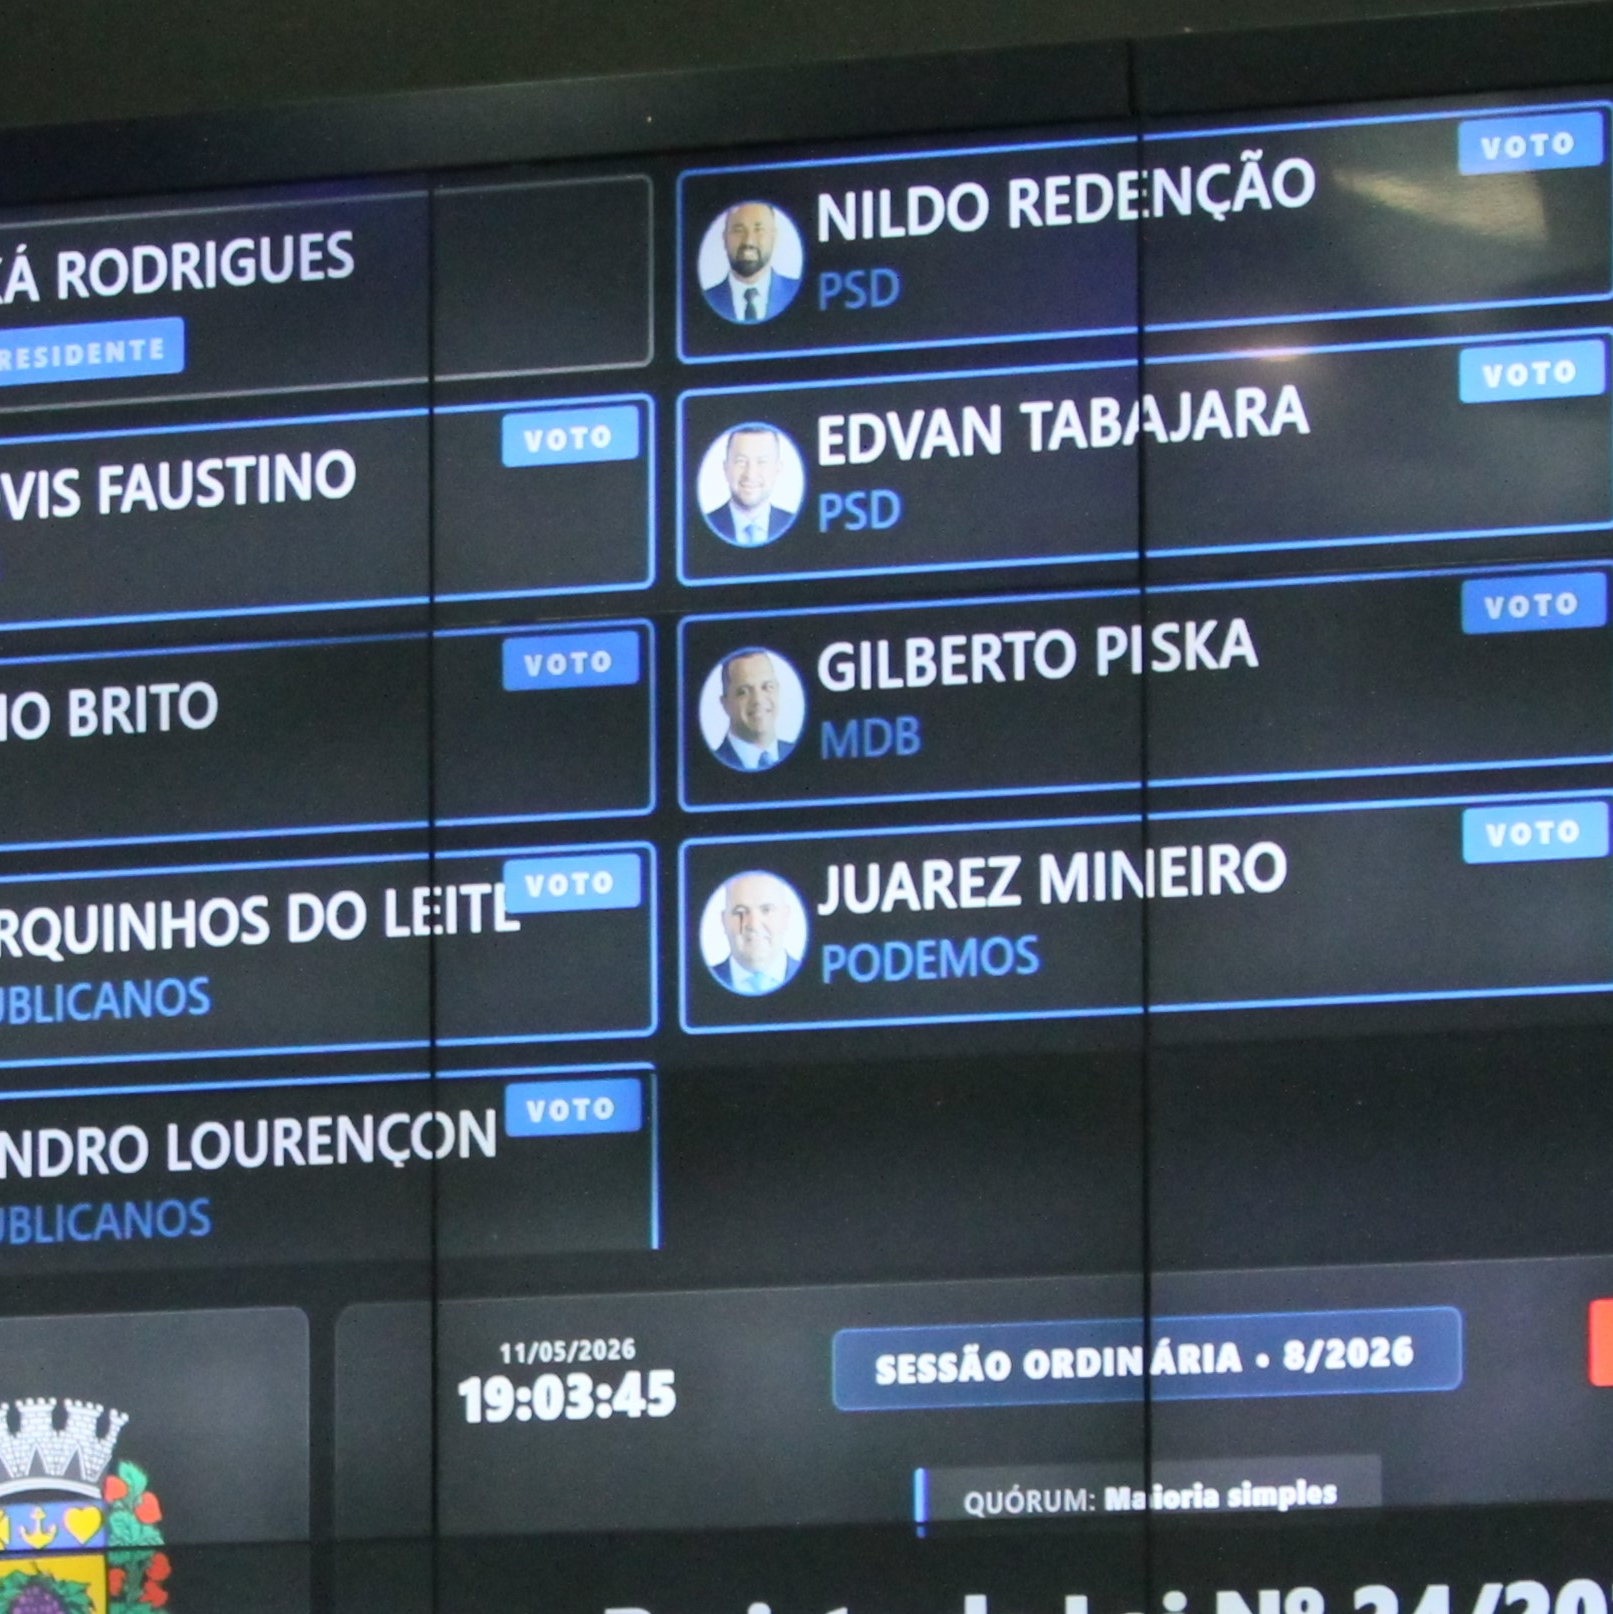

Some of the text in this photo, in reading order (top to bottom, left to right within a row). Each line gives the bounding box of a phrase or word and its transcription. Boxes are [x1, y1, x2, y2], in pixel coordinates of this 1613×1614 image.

[1481, 132, 1574, 158] VOTO
[817, 149, 1315, 242] NILDO REDENÇÃO
[57, 231, 354, 300] RODRIGUES
[818, 269, 900, 312] PSD
[1483, 359, 1576, 386] VOTO
[524, 424, 612, 452] VOTO
[817, 385, 1309, 466] EDVAN TABAJARA
[98, 450, 356, 516] FAUSTINO
[818, 490, 901, 533] PSD
[1484, 593, 1577, 619] VOTO
[524, 649, 612, 677] VOTO
[818, 619, 1259, 692] GILBERTO PISKA
[69, 681, 219, 737] BRITO
[820, 718, 920, 759] MDB
[1486, 820, 1579, 848] VOTO
[525, 871, 613, 898] VOTO
[818, 841, 1287, 916] JUAREZ MINEIRO
[288, 890, 367, 941] DO
[822, 936, 1039, 984] PODEMOS
[527, 1097, 614, 1124] VOTO
[168, 1108, 497, 1172] LOURENÇON
[500, 1338, 636, 1364] 11/05/2026
[875, 1346, 1011, 1385] SESSÃO
[1024, 1338, 1242, 1380] ORDINÁRIA
[1283, 1337, 1414, 1373] 8/2026
[458, 1369, 676, 1423] 19:03:45
[964, 1479, 1338, 1518] QUÓRUM: Maioria simples
